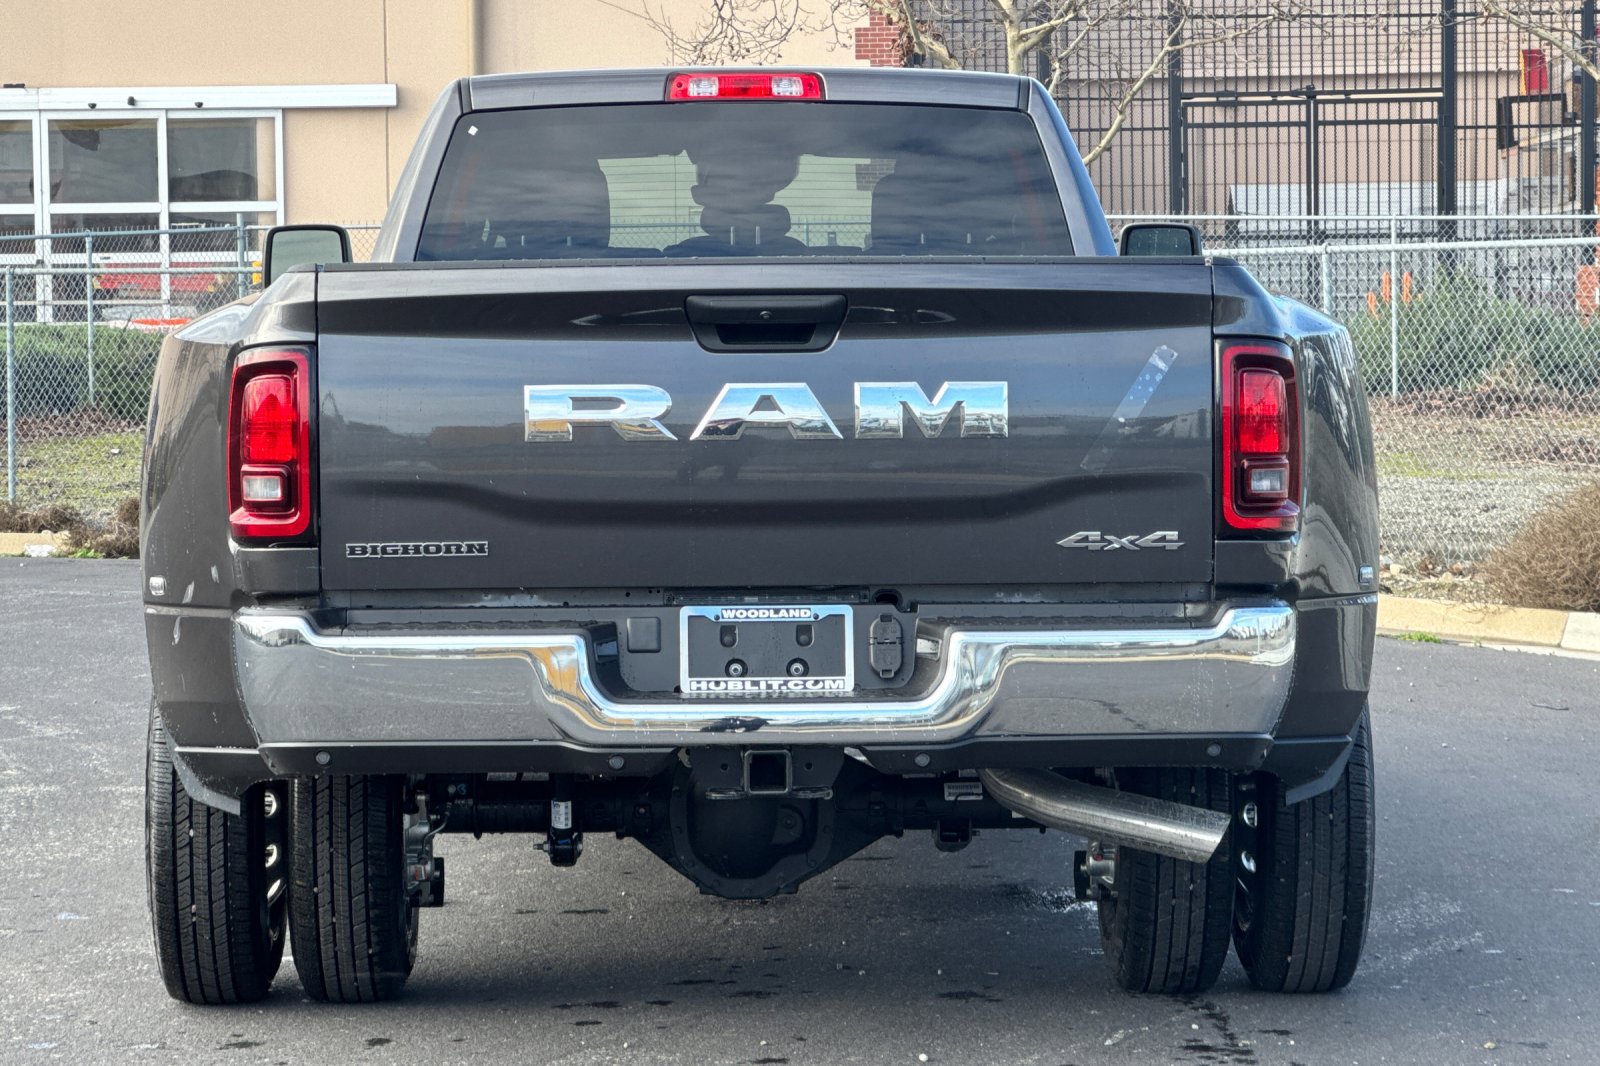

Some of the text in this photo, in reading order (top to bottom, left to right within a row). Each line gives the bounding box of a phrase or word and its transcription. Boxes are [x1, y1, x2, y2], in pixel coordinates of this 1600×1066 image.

[523, 381, 1009, 441] RAM
[345, 541, 488, 558] BIGHORN
[721, 608, 811, 619] WOODLAND
